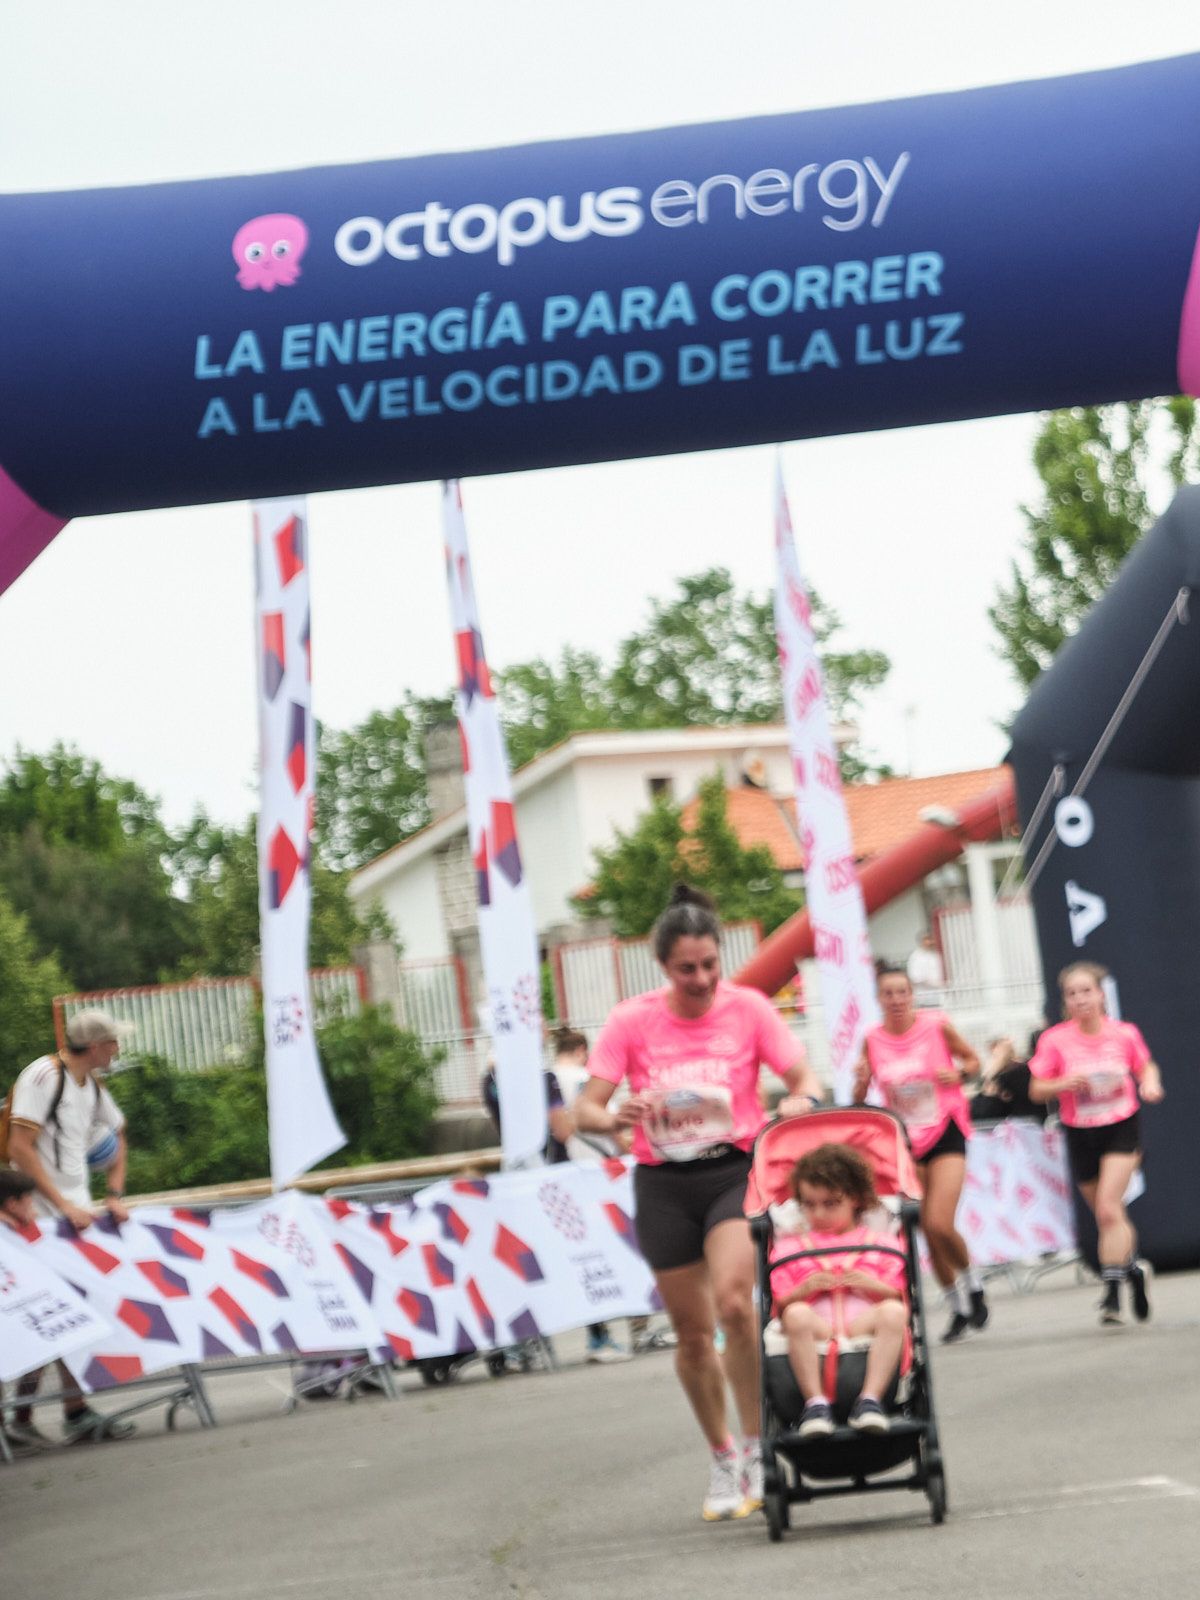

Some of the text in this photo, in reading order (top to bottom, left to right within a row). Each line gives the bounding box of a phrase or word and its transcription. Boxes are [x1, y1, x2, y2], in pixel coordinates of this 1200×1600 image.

[335, 150, 911, 266] octopus energy
[194, 251, 945, 380] LA ENERGÍA PARA CORRER
[197, 313, 965, 438] A LA VELOCIDAD DE LA LUZ
